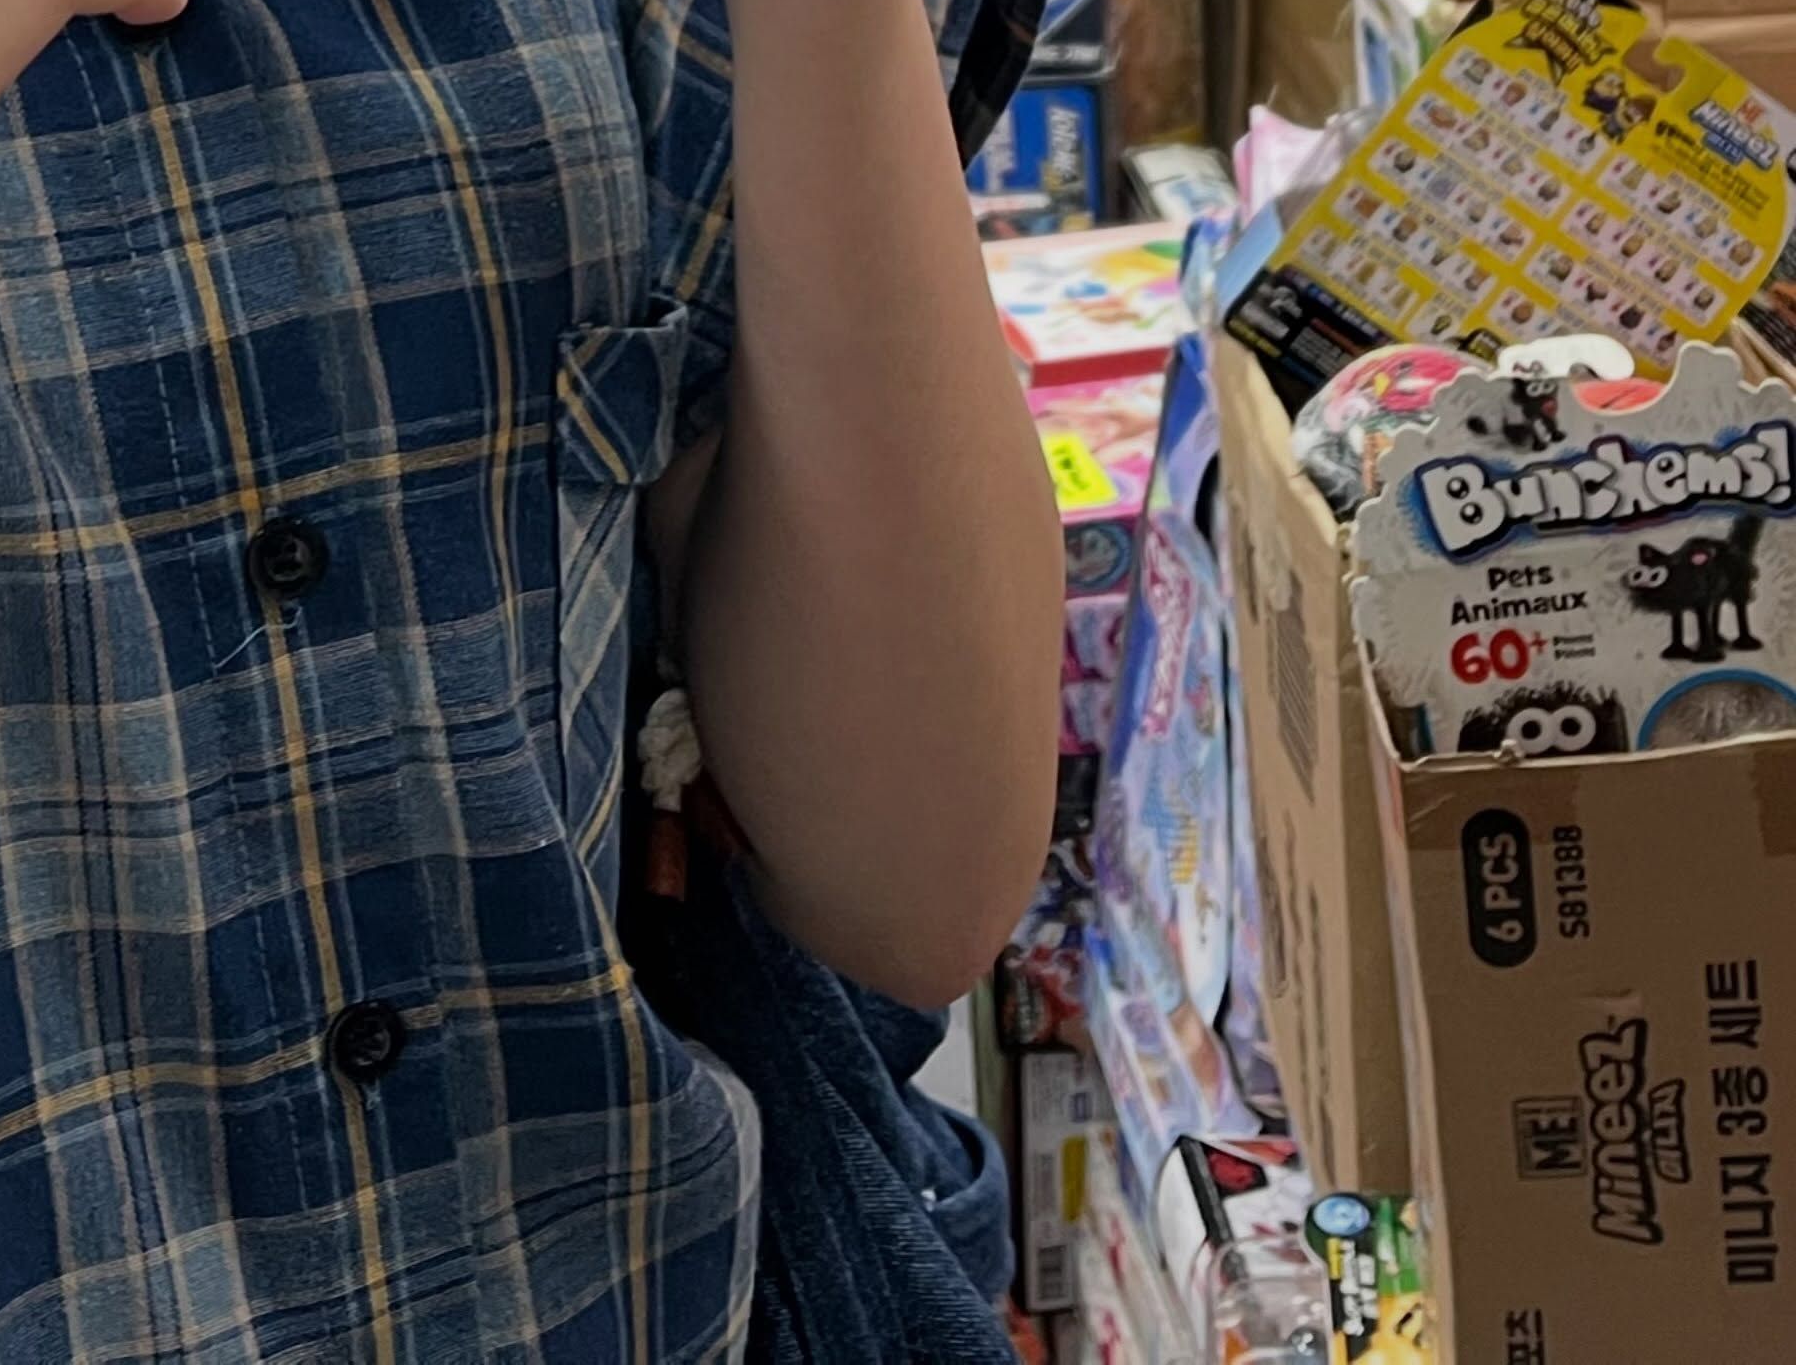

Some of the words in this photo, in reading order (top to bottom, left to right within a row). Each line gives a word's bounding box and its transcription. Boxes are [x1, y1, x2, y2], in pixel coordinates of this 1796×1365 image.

[1419, 425, 1794, 554] Bunchems!
[1450, 589, 1589, 627] Animaux
[1487, 565, 1555, 591] Pets
[1480, 831, 1525, 910] PCS
[1552, 825, 1590, 939] S81388
[1484, 918, 1526, 943] 6
[1706, 958, 1763, 1050] 세트
[1577, 1015, 1665, 1246] Mineez
[1711, 1065, 1770, 1137] 3종
[1719, 1153, 1781, 1285] 미니지
